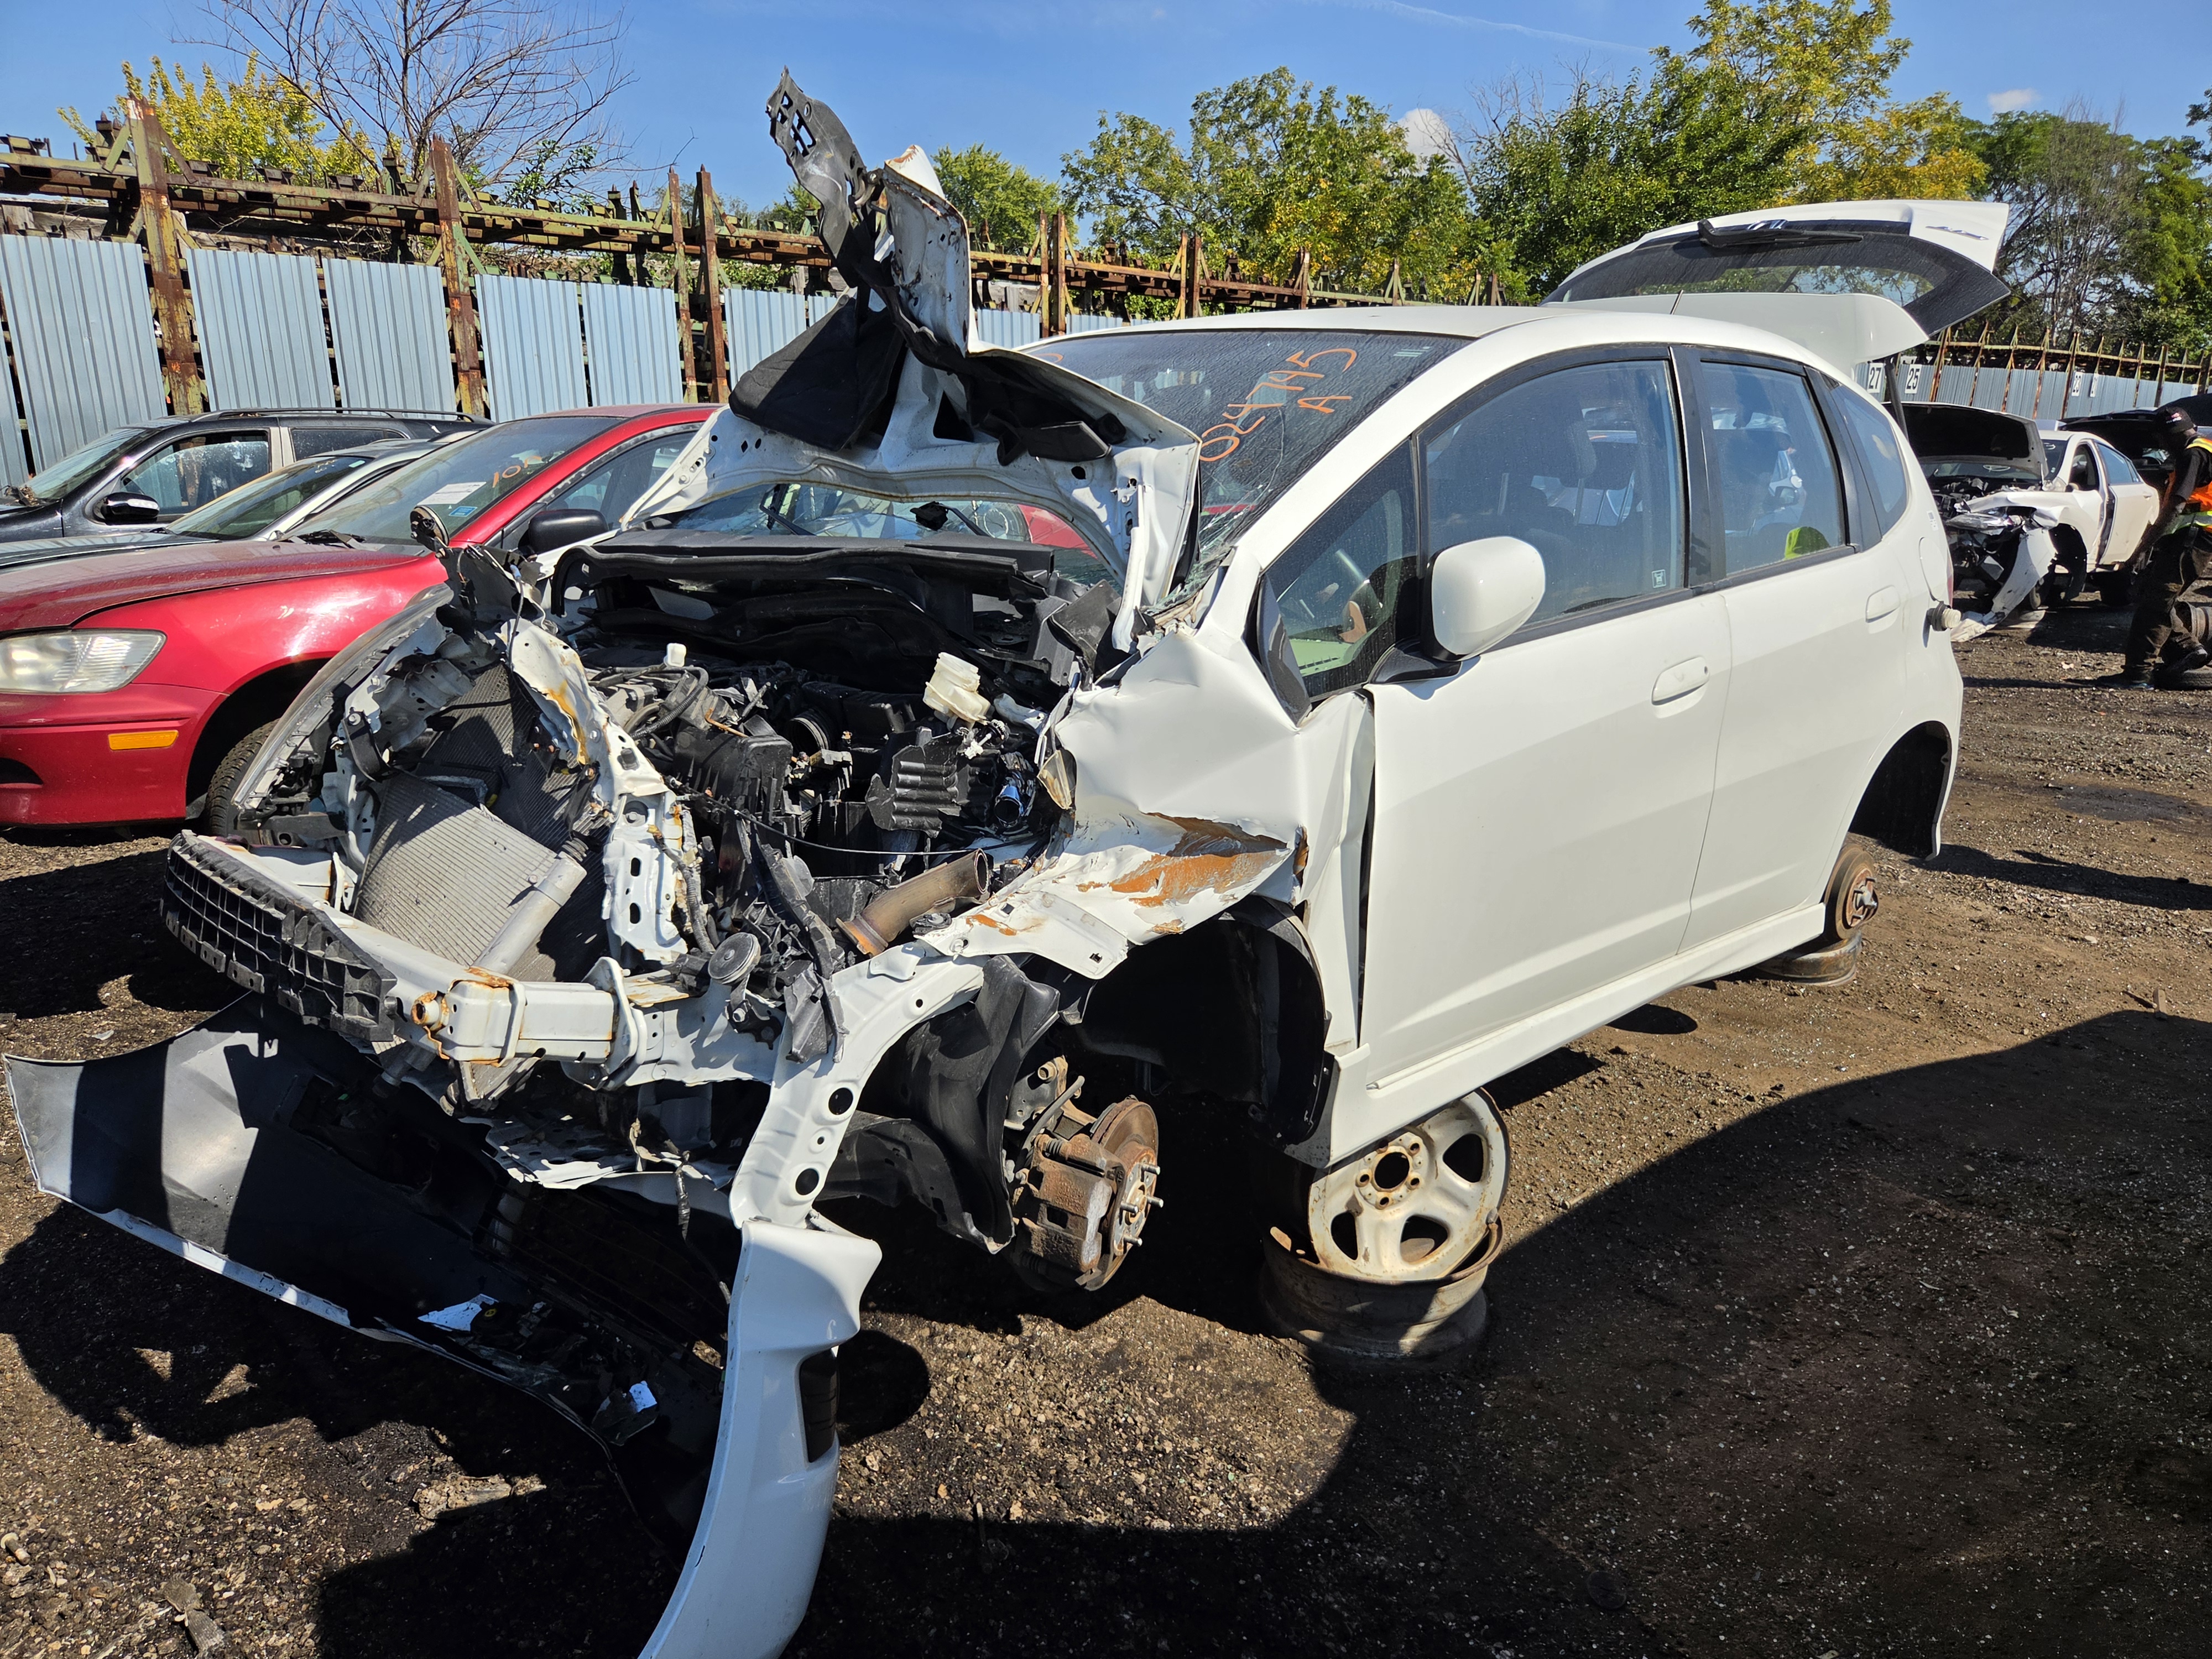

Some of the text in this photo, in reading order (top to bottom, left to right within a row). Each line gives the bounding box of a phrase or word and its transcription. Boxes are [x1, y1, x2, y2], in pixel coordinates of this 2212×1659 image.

[1868, 367, 1882, 389] 27
[1906, 368, 1921, 390] 25
[1297, 395, 1353, 414] A
